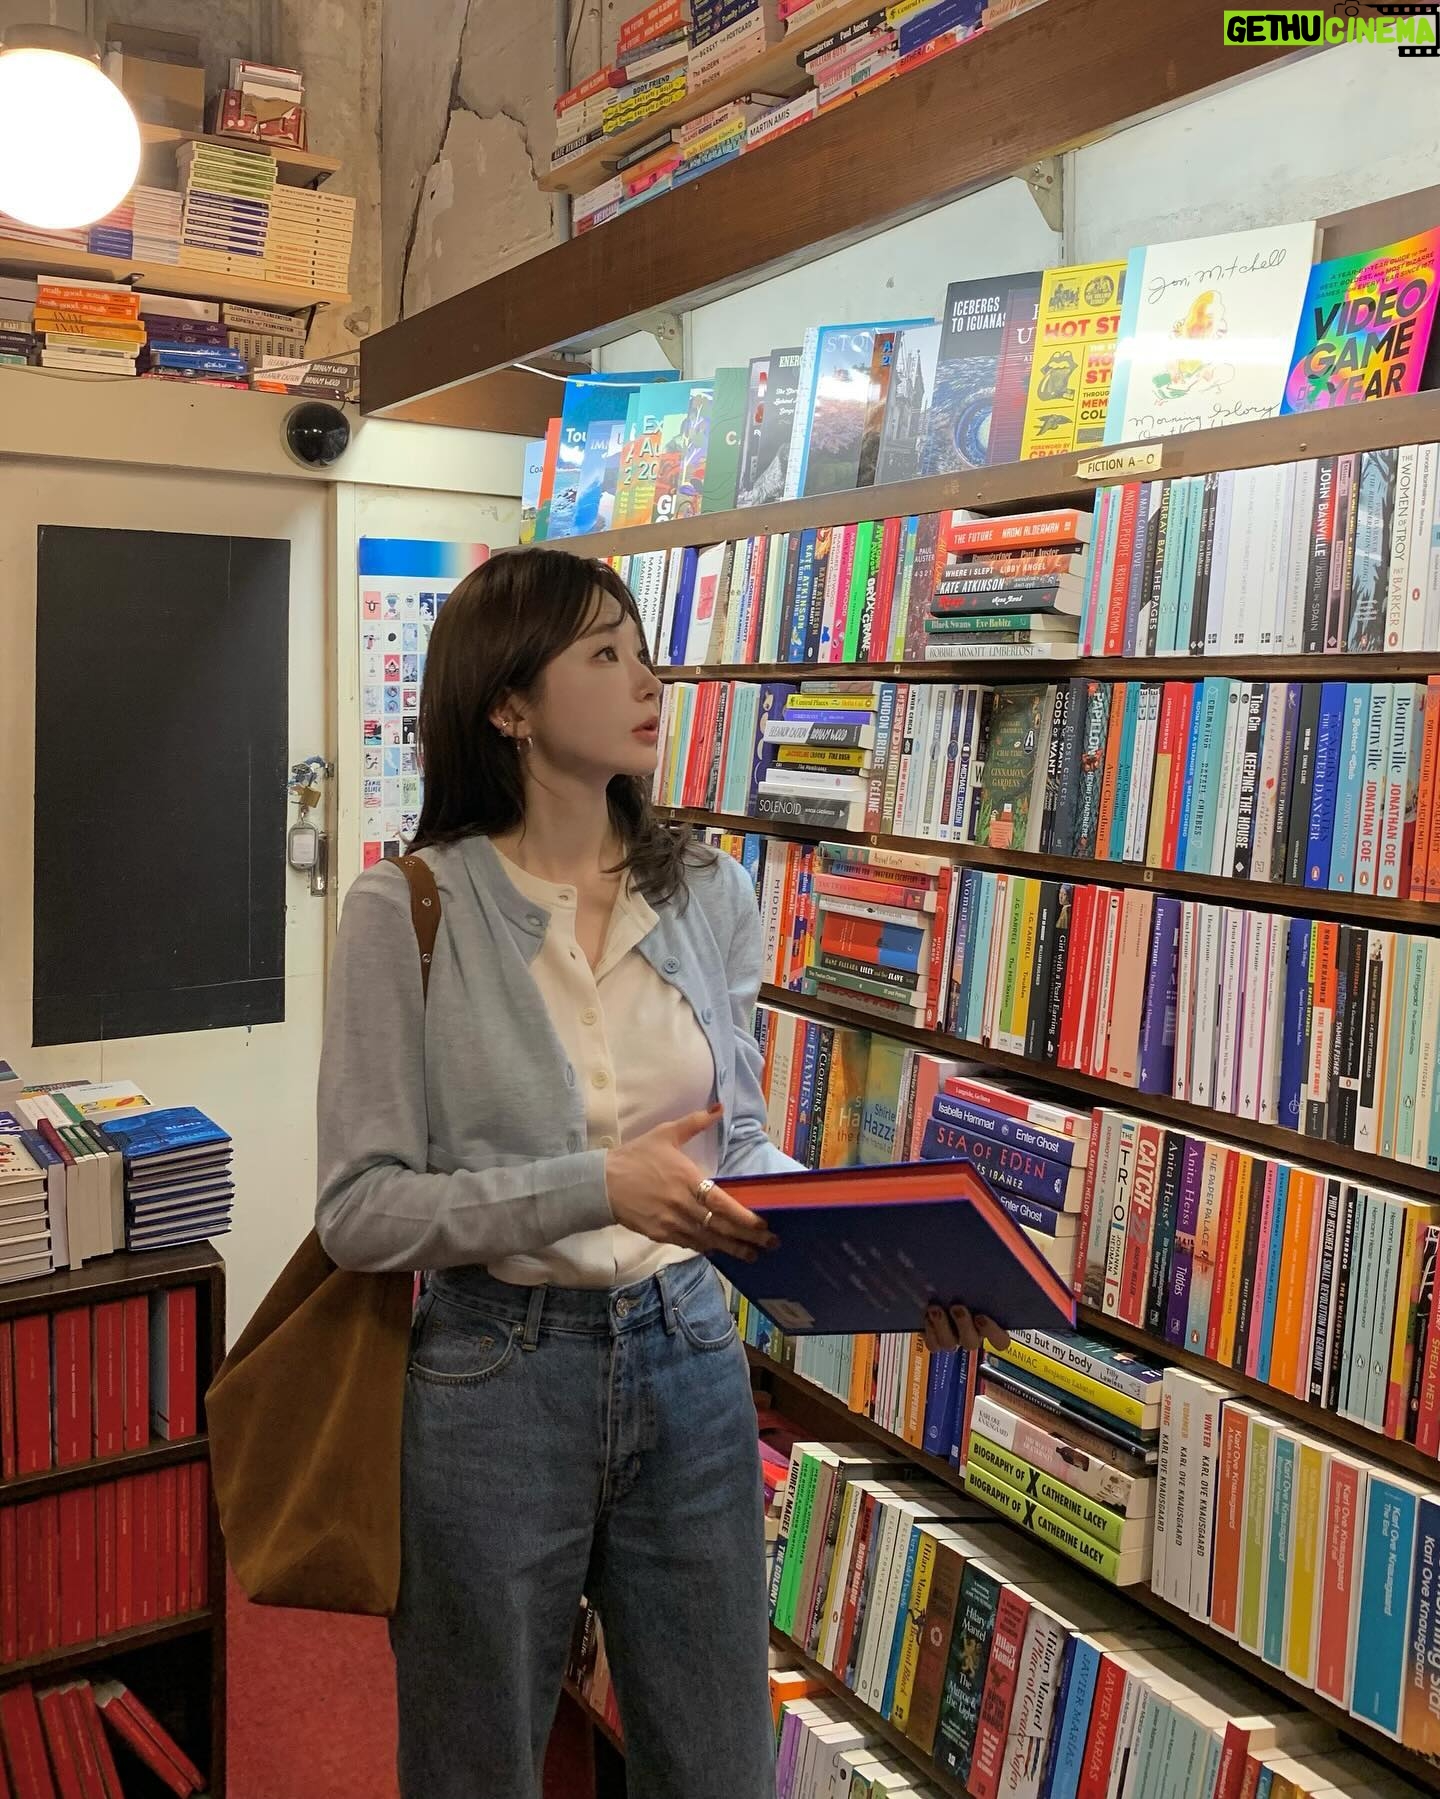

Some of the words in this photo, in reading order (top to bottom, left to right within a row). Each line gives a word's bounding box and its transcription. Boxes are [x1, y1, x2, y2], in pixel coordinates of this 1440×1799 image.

[840, 28, 851, 40] Paul
[853, 19, 868, 32] Auster
[633, 84, 648, 95] BODY
[649, 74, 670, 88] FRIEND
[750, 121, 773, 136] MARTIN
[774, 109, 790, 124] AMIS
[1199, 248, 1287, 283] Mitchell
[953, 297, 1001, 316] ICEBERGS
[1314, 279, 1427, 341] VIDEO
[952, 318, 966, 333] TO
[1045, 319, 1091, 337] HOT
[1304, 318, 1416, 378] GAME
[1328, 362, 1406, 410] YEAR
[1128, 413, 1202, 428] Morning
[1208, 401, 1280, 420] Glory
[1088, 458, 1123, 473] FICTION
[1318, 467, 1332, 498] JOHN
[1122, 489, 1135, 526] ANXIOUS
[1159, 487, 1171, 534] MURRAY
[1119, 528, 1131, 558] PEOPLE
[1314, 503, 1328, 557] BANVILLE
[804, 544, 813, 570] KATE
[846, 532, 855, 576] MARGARET
[1155, 539, 1166, 565] BAIL
[818, 567, 826, 587] KATE
[940, 582, 959, 594] KATE
[962, 578, 1005, 592] ATKINSON
[1114, 564, 1126, 593] FREDRIK
[1152, 568, 1162, 590] THE
[1313, 565, 1322, 591] APRIL
[798, 576, 810, 629] ATKINSON
[812, 590, 823, 635] ATKINSON
[842, 579, 850, 617] ATWOOD
[1149, 595, 1160, 630] PAGES
[1109, 597, 1123, 634] BACKMAN
[1310, 603, 1320, 631] SPAIN
[1052, 691, 1063, 724] GODS
[1250, 694, 1264, 714] Tice
[1322, 712, 1330, 729] THE
[1053, 727, 1059, 737] OF
[1247, 717, 1261, 731] Cin
[1367, 695, 1387, 770] Bournville
[1390, 697, 1411, 774] Bournville
[1047, 740, 1058, 775] WANT
[1241, 752, 1258, 792] KEEPING
[1314, 732, 1329, 779] WATER
[958, 764, 967, 795] MICHAEL
[759, 799, 801, 815] SOLENOID
[955, 797, 965, 824] CHABON
[1239, 795, 1252, 814] THE
[1309, 784, 1324, 840] DANCER
[1361, 779, 1377, 836] JONATHAN
[1386, 783, 1402, 839] JONATHAN
[1235, 816, 1251, 849] HOUSE
[1360, 840, 1373, 863] COE
[1384, 844, 1398, 866] COE
[766, 879, 781, 962] MIDDLESEX
[1057, 935, 1067, 951] Girl
[1055, 954, 1064, 969] with
[1052, 982, 1062, 1002] Pearl
[1049, 1004, 1060, 1035] Earring
[1333, 1021, 1343, 1048] SAMUEL
[1332, 1049, 1342, 1076] FISHER
[938, 1102, 963, 1120] Isabella
[963, 1110, 995, 1131] Hammad
[1016, 1128, 1036, 1145] Enter
[1037, 1135, 1060, 1153] Ghost
[937, 1127, 967, 1151] SEA
[973, 1141, 991, 1160] OF
[1000, 1149, 1047, 1179] EDEN
[1166, 1141, 1179, 1178] Anita
[1185, 1147, 1199, 1184] Anita
[1209, 1152, 1217, 1170] THE
[1114, 1149, 1131, 1221] TRIO
[1129, 1139, 1157, 1245] CATCH-22
[1162, 1183, 1175, 1219] Heiss
[1205, 1173, 1216, 1205] PAPER
[1000, 1195, 1019, 1212] Enter
[1020, 1202, 1043, 1223] Ghost
[1181, 1189, 1195, 1226] Heiss
[1326, 1195, 1338, 1218] PHILIP
[1201, 1208, 1213, 1246] PALACE
[1323, 1220, 1336, 1250] HENSHER
[1107, 1235, 1116, 1273] HEDMAN
[1112, 1235, 1122, 1276] JOHANNA
[1320, 1258, 1333, 1281] SMALL
[1174, 1266, 1188, 1296] Tiddas
[1316, 1282, 1331, 1325] REVOLUTION
[1316, 1327, 1327, 1335] IN
[1034, 1333, 1050, 1351] but
[1052, 1345, 1066, 1360] my
[1068, 1350, 1093, 1373] body
[1313, 1337, 1326, 1372] GERMANY
[1427, 1337, 1439, 1379] SHEILA
[1162, 1394, 1172, 1426] SPRING
[1424, 1382, 1435, 1411] HETI
[1181, 1402, 1191, 1439] SUMMER
[1202, 1413, 1213, 1448] WINTER
[1159, 1433, 1170, 1456] KARL
[1233, 1429, 1243, 1448] Karl
[1159, 1457, 1168, 1474] OVE
[1178, 1446, 1188, 1468] KARL
[1201, 1455, 1211, 1478] KARL
[1232, 1450, 1241, 1470] Ove
[787, 1460, 800, 1497] AUDREY
[973, 1443, 1014, 1479] BIOGRAPHY
[1015, 1469, 1025, 1482] OF
[1026, 1467, 1039, 1499] X
[1041, 1484, 1082, 1517] CATHERINE
[1083, 1507, 1108, 1531] LACEY
[1178, 1470, 1187, 1487] OVE
[1200, 1480, 1209, 1496] OVE
[781, 1499, 793, 1534] MAGEE
[1156, 1476, 1168, 1532] KNAUSGAARD
[1228, 1472, 1240, 1529] Knausgaard
[1391, 1506, 1401, 1527] Karl
[969, 1474, 1010, 1508] BIOGRAPHY
[1011, 1499, 1022, 1514] OF
[1022, 1498, 1035, 1530] X
[1038, 1515, 1079, 1550] CATHERINE
[1080, 1539, 1105, 1565] LACEY
[1174, 1489, 1186, 1547] KNAUSGAARD
[1196, 1499, 1208, 1557] KNAUSGAARD
[776, 1545, 785, 1565] THE
[1389, 1529, 1399, 1551] Ove
[1422, 1535, 1435, 1568] Karl
[769, 1566, 782, 1607] COLONY
[1384, 1552, 1398, 1616] Knausgaard
[1421, 1567, 1433, 1598] Ove
[1041, 1629, 1058, 1676] Hilary
[1414, 1600, 1430, 1689] Knausgaard
[1075, 1654, 1091, 1706] JAVIER
[1100, 1667, 1116, 1721] JAVIER
[1034, 1679, 1050, 1732] Mantel
[1065, 1707, 1082, 1768] MARÍAS
[1089, 1722, 1107, 1781] MARÍAS
